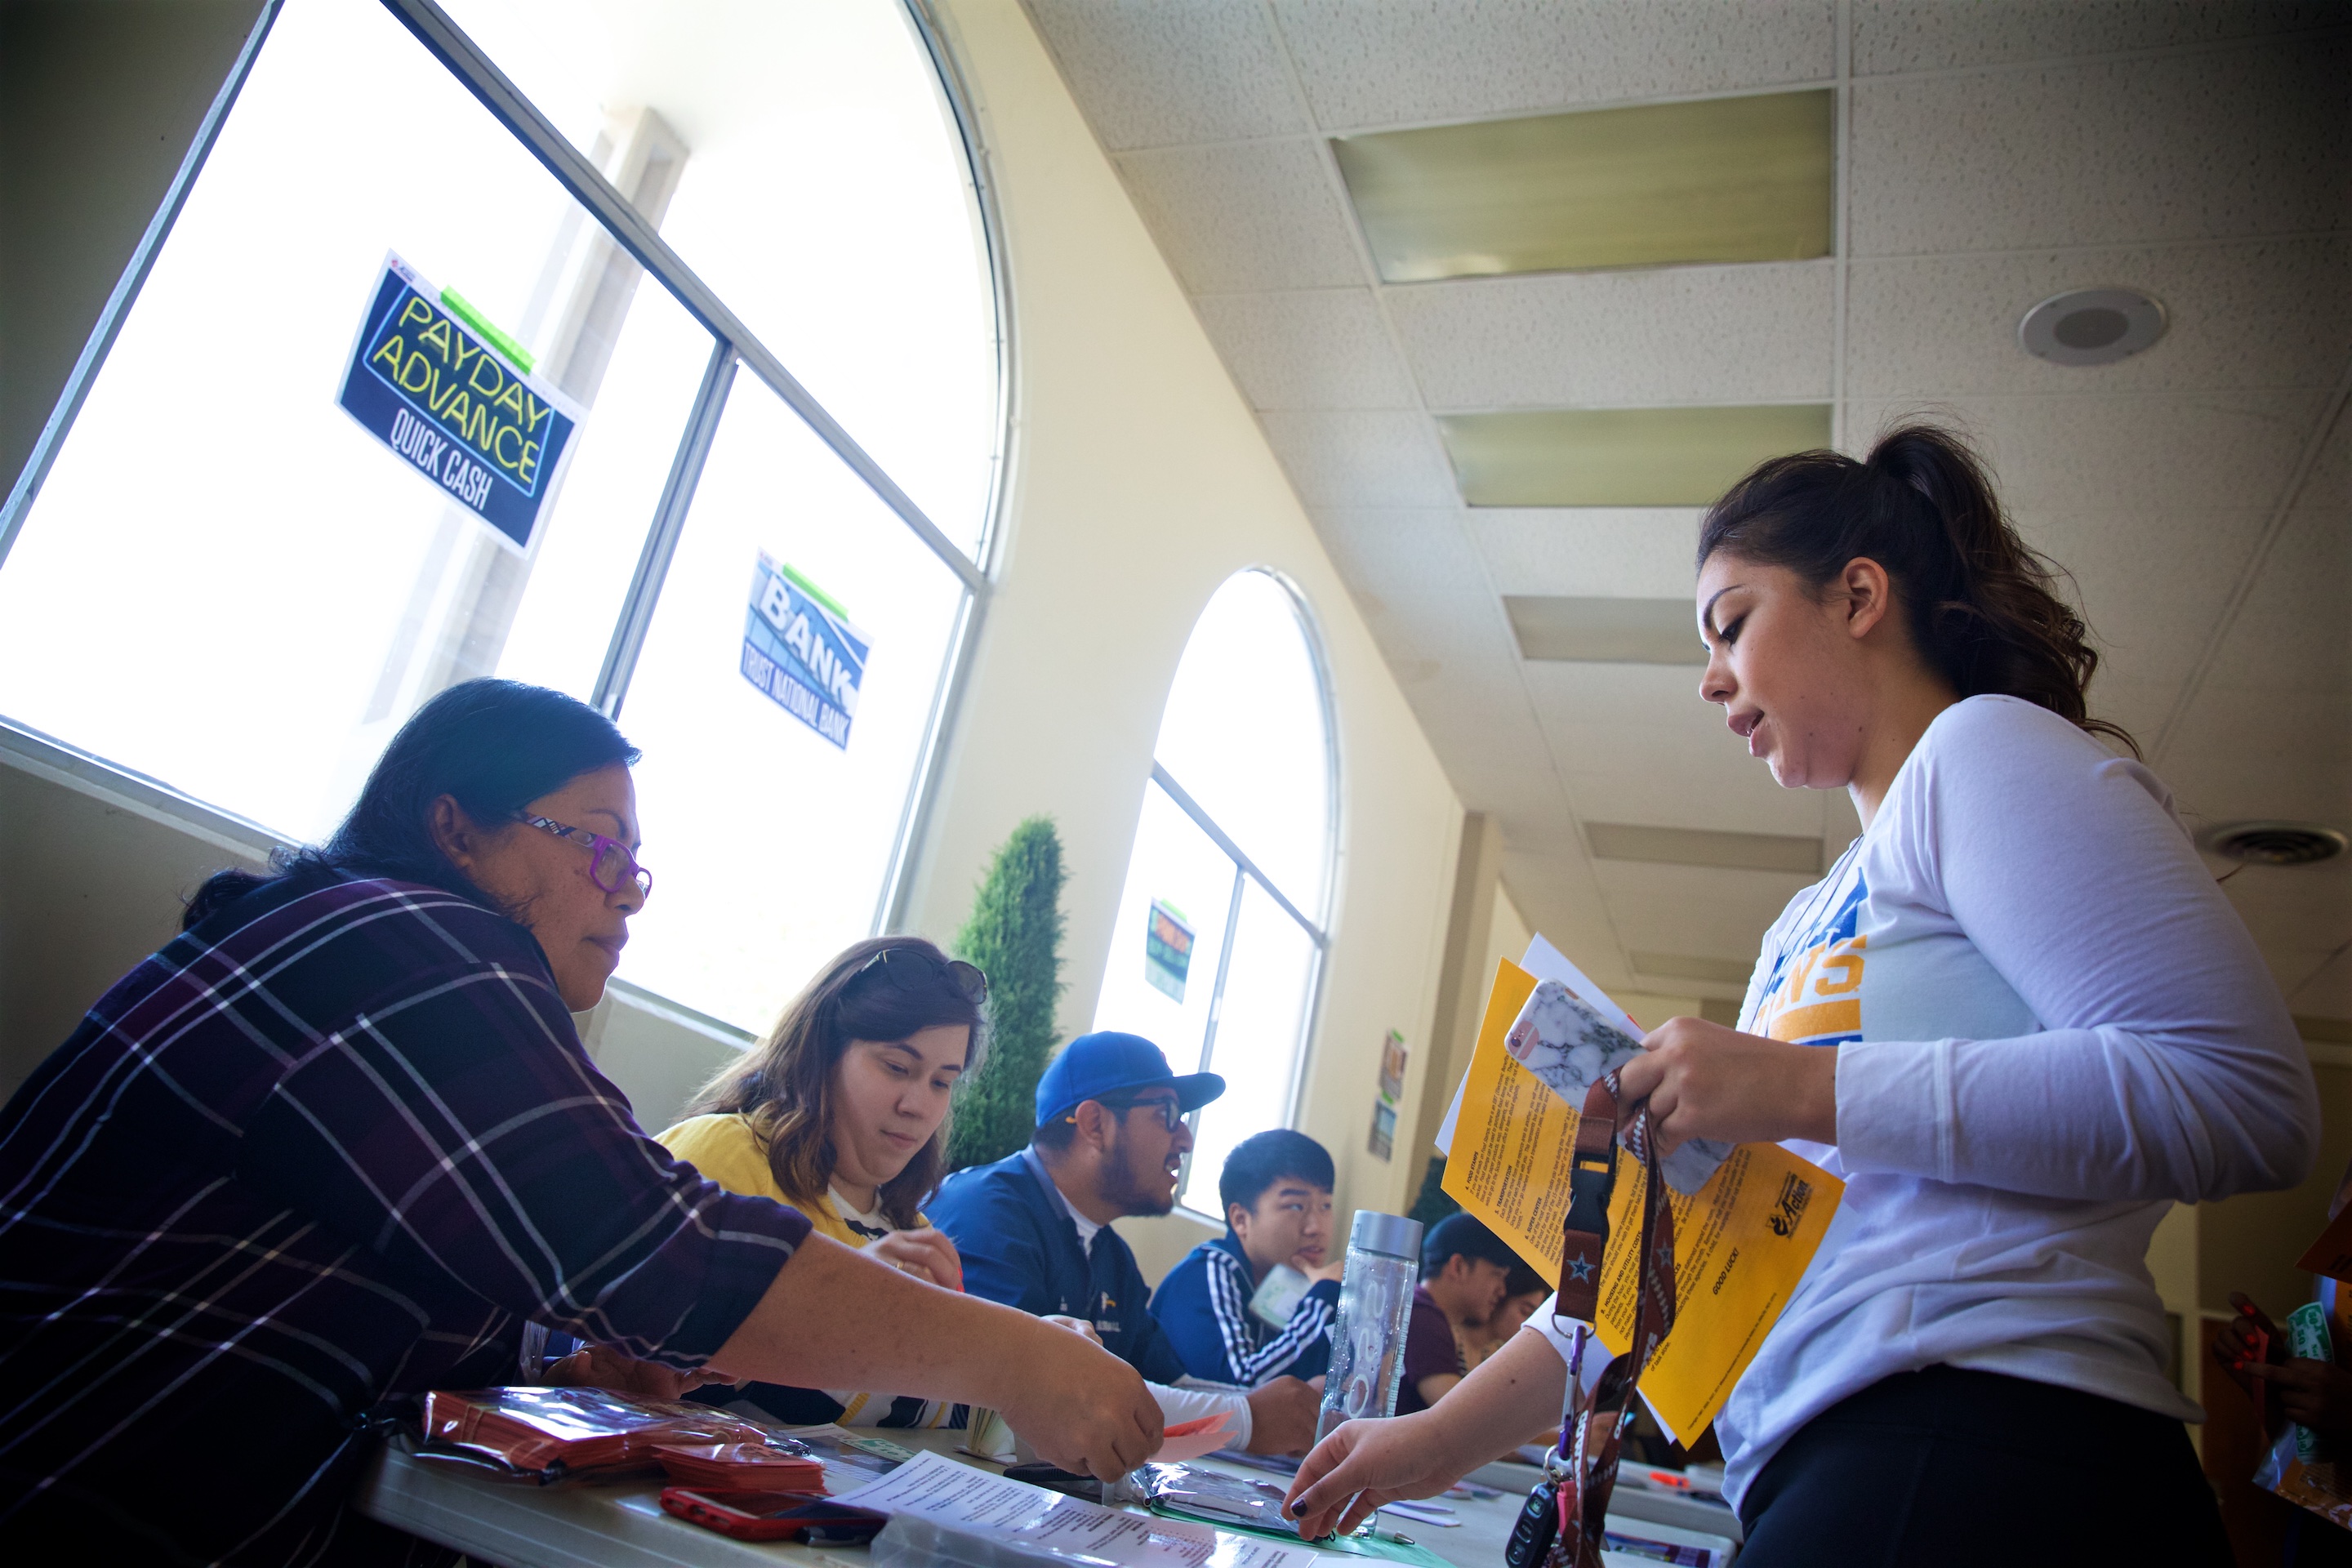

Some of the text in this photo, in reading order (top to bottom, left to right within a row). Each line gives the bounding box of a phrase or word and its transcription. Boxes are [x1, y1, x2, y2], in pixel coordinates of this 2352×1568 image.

[399, 296, 550, 433] PAYDAY
[372, 335, 541, 484] ADVANCE
[390, 408, 493, 511] QUICK CASH
[759, 572, 858, 715] BANK
[771, 666, 821, 728] NATIONAL
[817, 702, 851, 747] BANK
[1470, 1150, 1478, 1170] STAMPS
[1494, 1163, 1512, 1215] 5. TRANSPORTATION
[1780, 1179, 1809, 1225] Action
[1524, 1196, 1542, 1241] 6. SUPER CENTER
[1600, 1228, 1642, 1315] 9. HOUSING AND UTILITY COSTS
[1604, 1302, 1616, 1321] During
[1627, 1260, 1636, 1274] must
[1712, 1247, 1740, 1296] GOOD LUCK!
[1613, 1316, 1623, 1330] from
[1620, 1306, 1628, 1319] your
[1653, 1354, 1662, 1366] task
